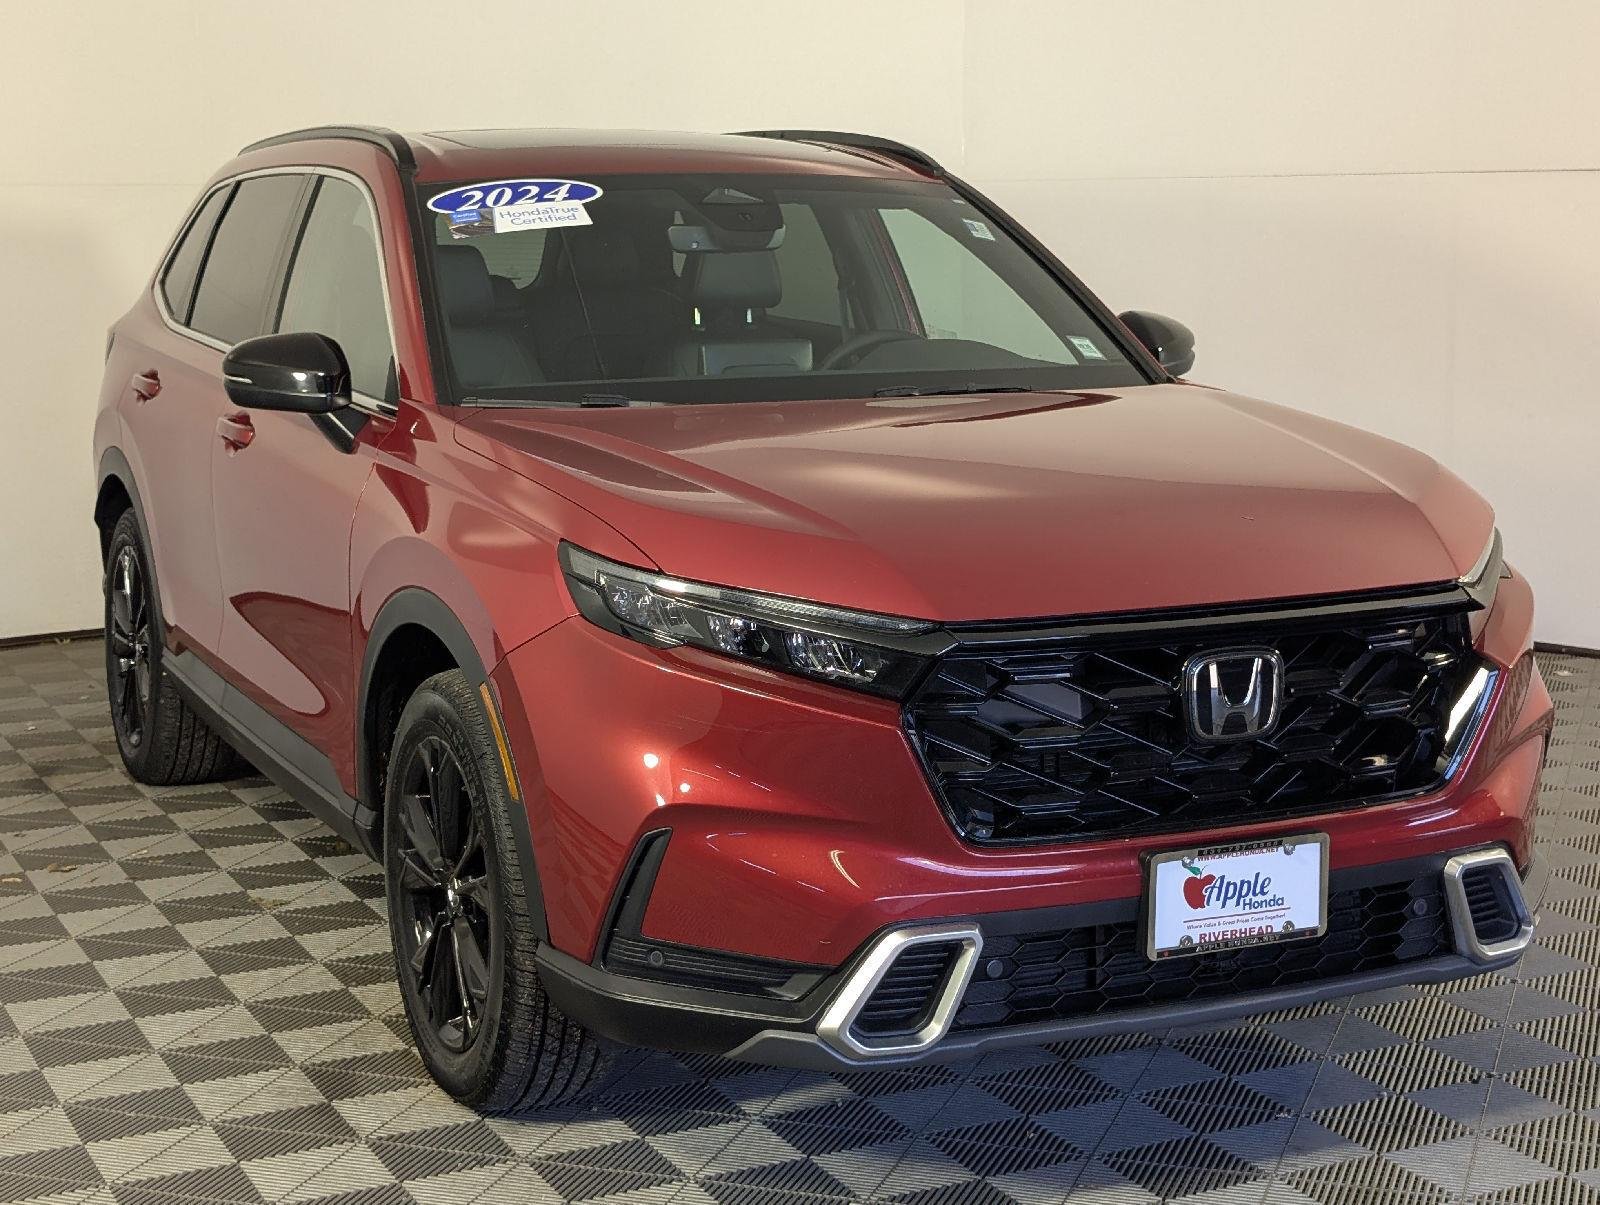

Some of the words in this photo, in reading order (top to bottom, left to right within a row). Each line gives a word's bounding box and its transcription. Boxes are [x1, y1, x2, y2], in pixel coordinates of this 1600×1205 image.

[456, 183, 572, 211] 2024
[510, 212, 577, 226] Certified
[1204, 871, 1272, 910] Apple
[1242, 893, 1285, 911] Honda
[1198, 924, 1274, 943] RIVERHEAD
